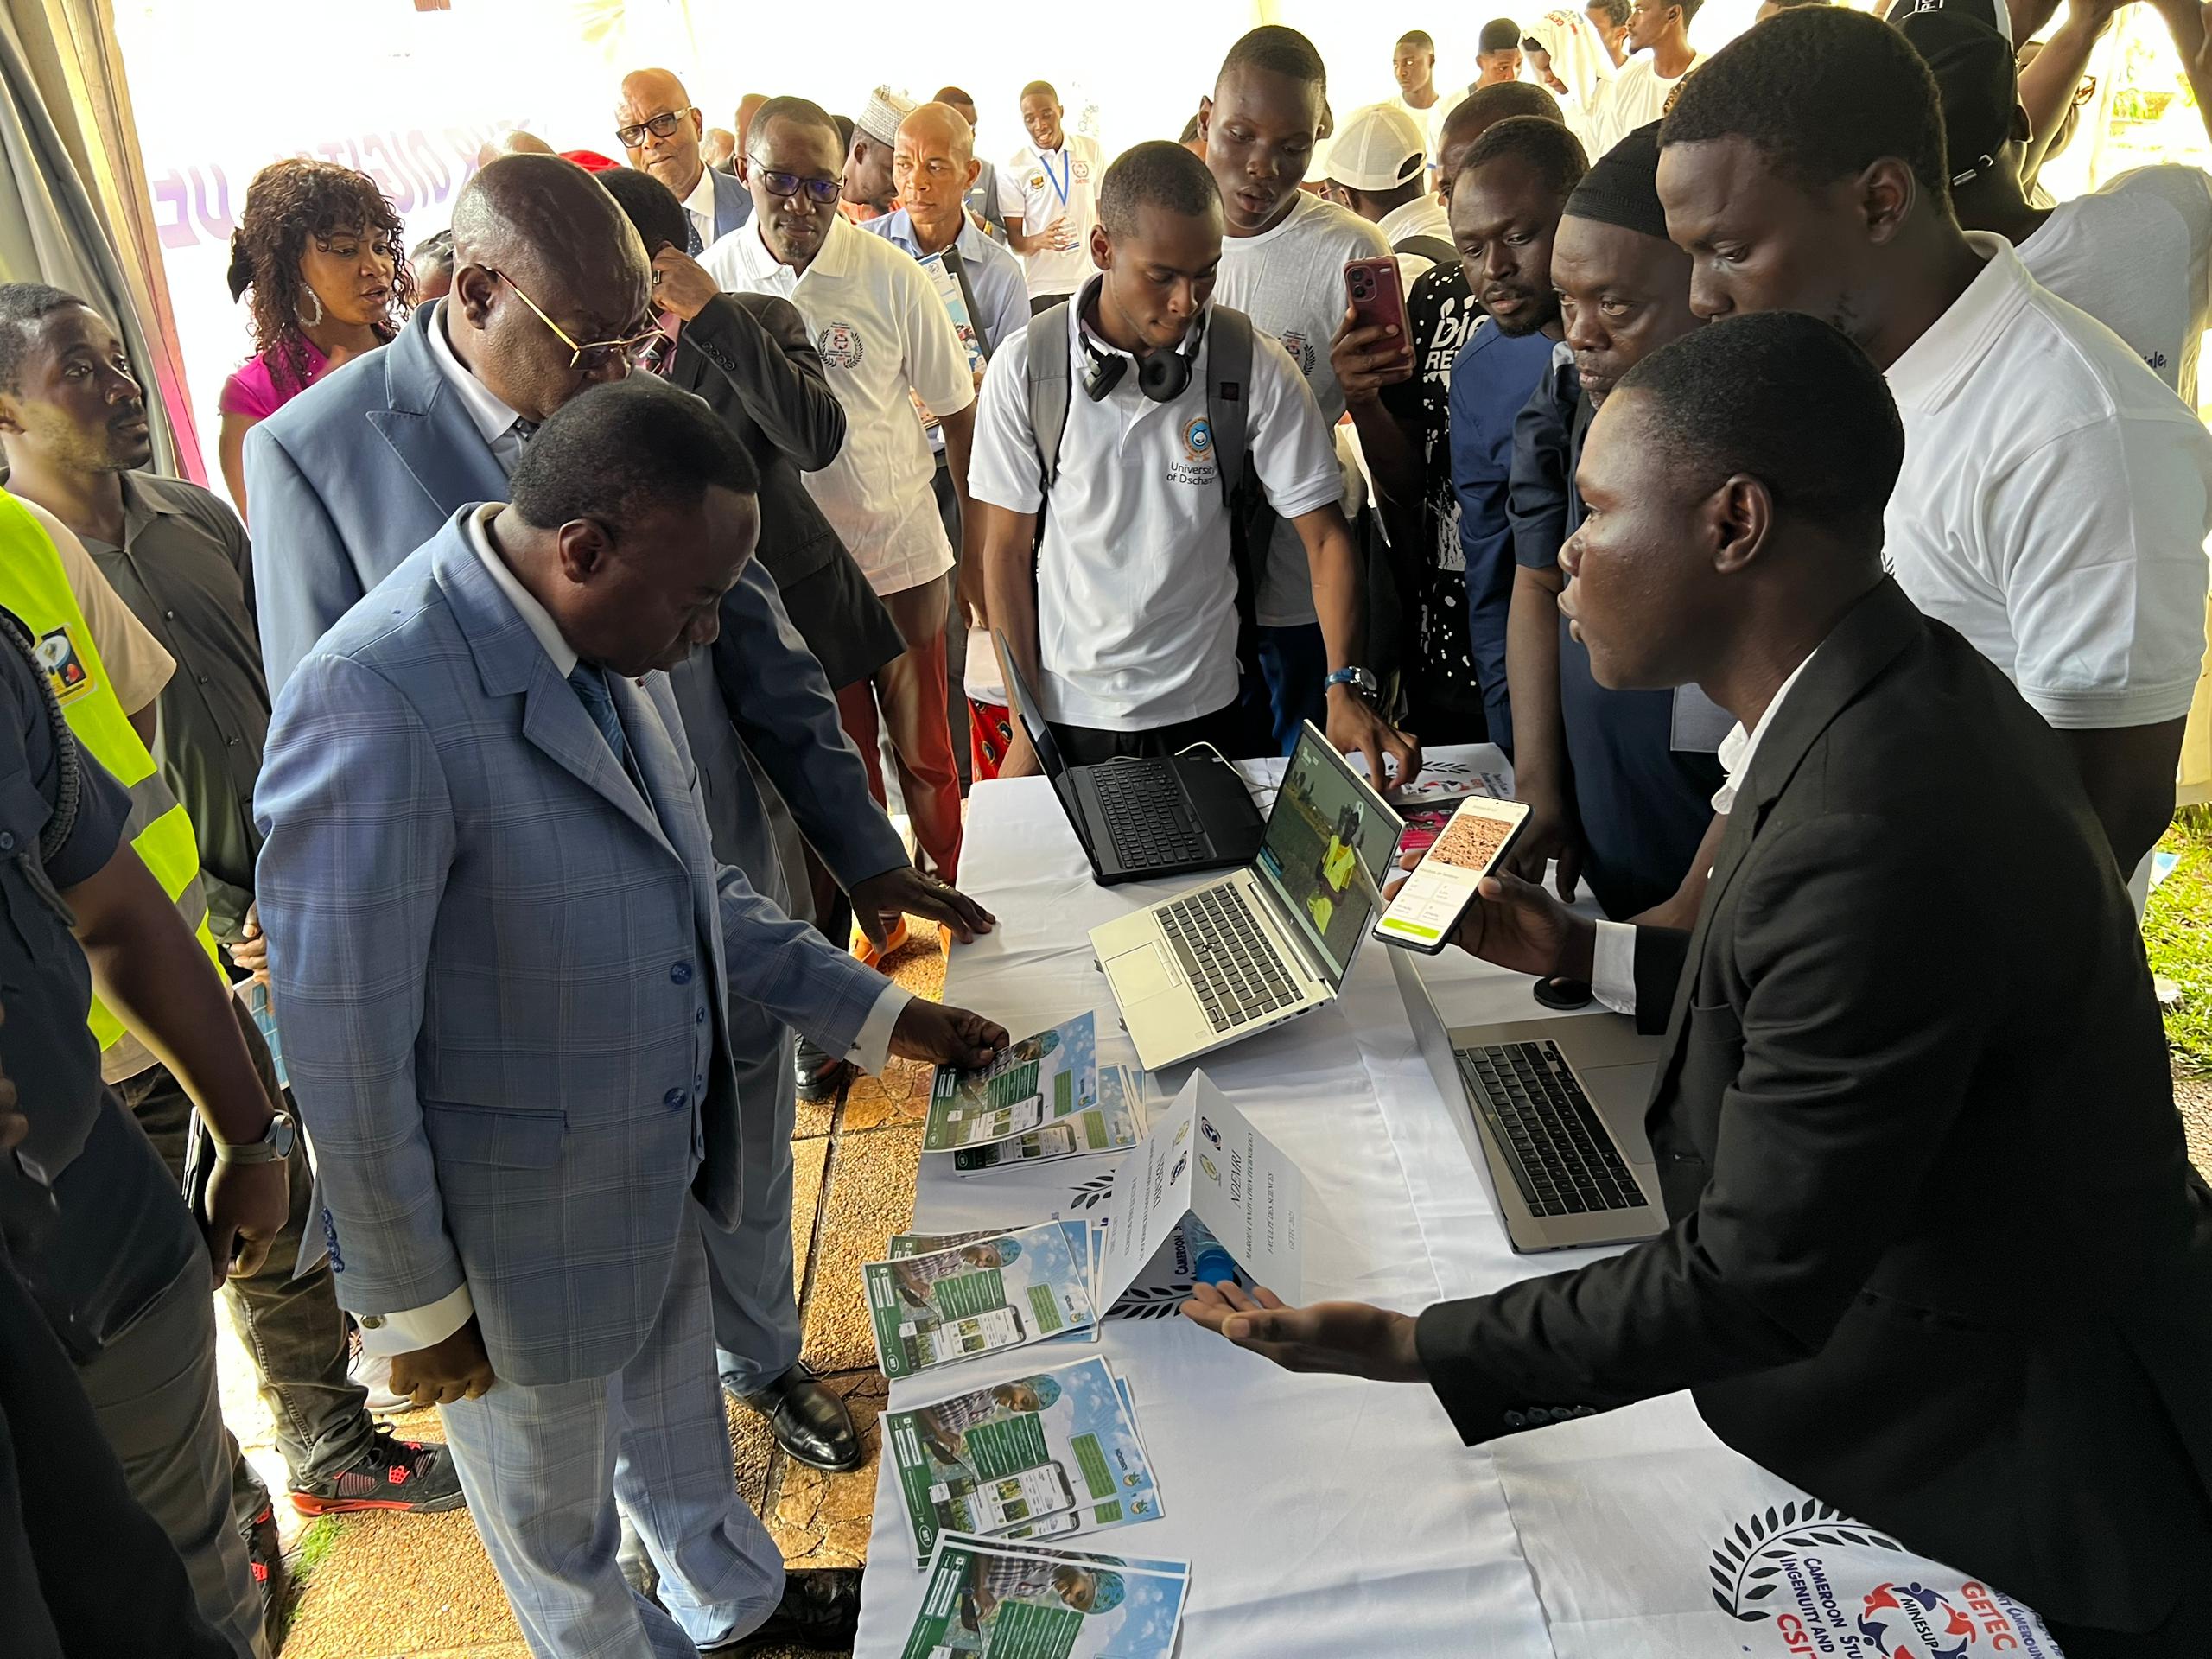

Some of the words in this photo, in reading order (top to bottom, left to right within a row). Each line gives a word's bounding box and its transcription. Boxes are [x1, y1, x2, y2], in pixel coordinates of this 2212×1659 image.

[1425, 350, 1459, 370] RE
[1166, 473, 1177, 481] of
[1230, 1148, 1242, 1208] NDEMRI
[1173, 1235, 1189, 1275] CAMEROON
[1780, 1558, 1822, 1624] INGENUITY
[1811, 1627, 1834, 1653] AND
[1804, 1558, 1847, 1628] CAMEROON
[1961, 1581, 2018, 1651] GETEC
[1899, 1598, 1940, 1649] MINESUP
